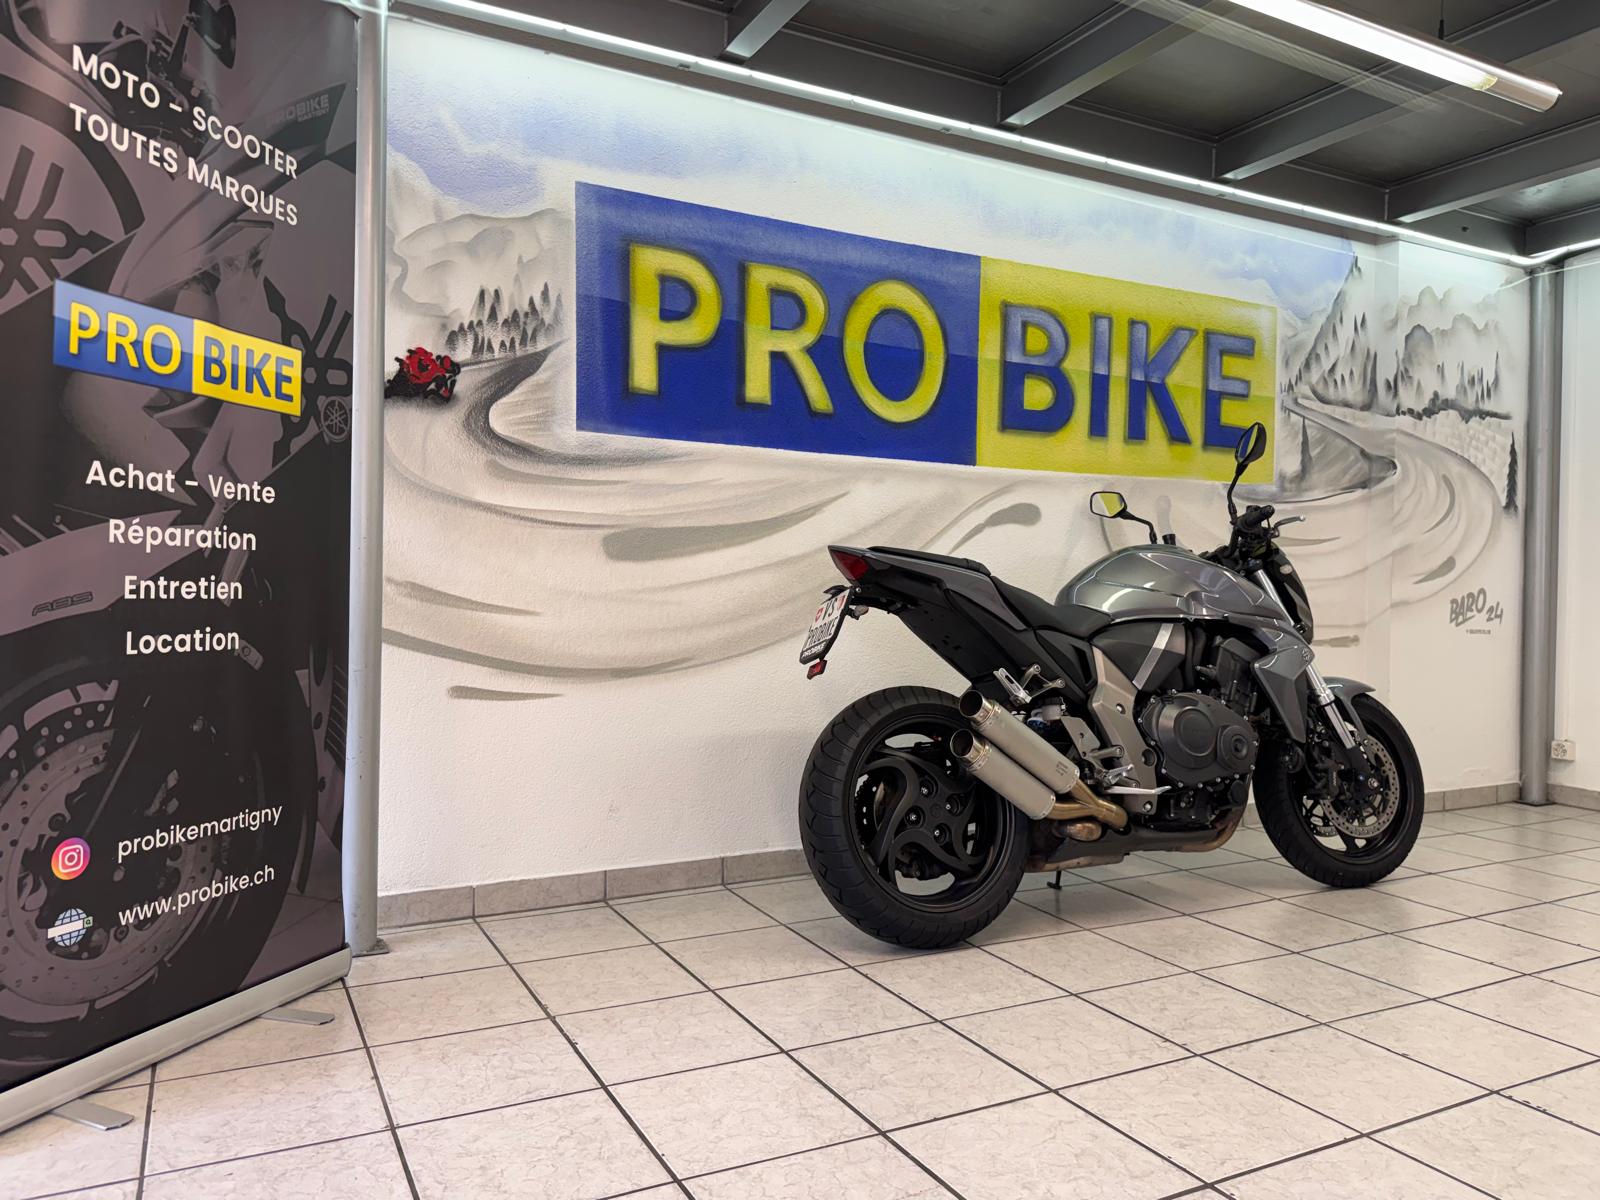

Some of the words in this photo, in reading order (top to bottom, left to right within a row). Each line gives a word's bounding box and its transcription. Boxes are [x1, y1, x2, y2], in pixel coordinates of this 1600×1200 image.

[72, 44, 160, 108] MOTO
[192, 106, 298, 179] SCOOTER
[69, 103, 178, 173] TOUTES
[187, 157, 298, 226] MARQUES
[69, 302, 182, 375] PRO
[203, 336, 294, 402] BIKE
[628, 243, 946, 424] PRO
[1001, 303, 1255, 448] BIKE
[86, 460, 175, 493] Achat
[208, 475, 275, 504] Vente
[108, 517, 256, 553] Réparation
[124, 575, 243, 600] Entretien
[1449, 588, 1487, 627] BARO
[1486, 601, 1504, 624] 24
[126, 627, 240, 655] Location
[118, 806, 283, 862] probikemartigny
[118, 865, 275, 926] www.probike.ch
